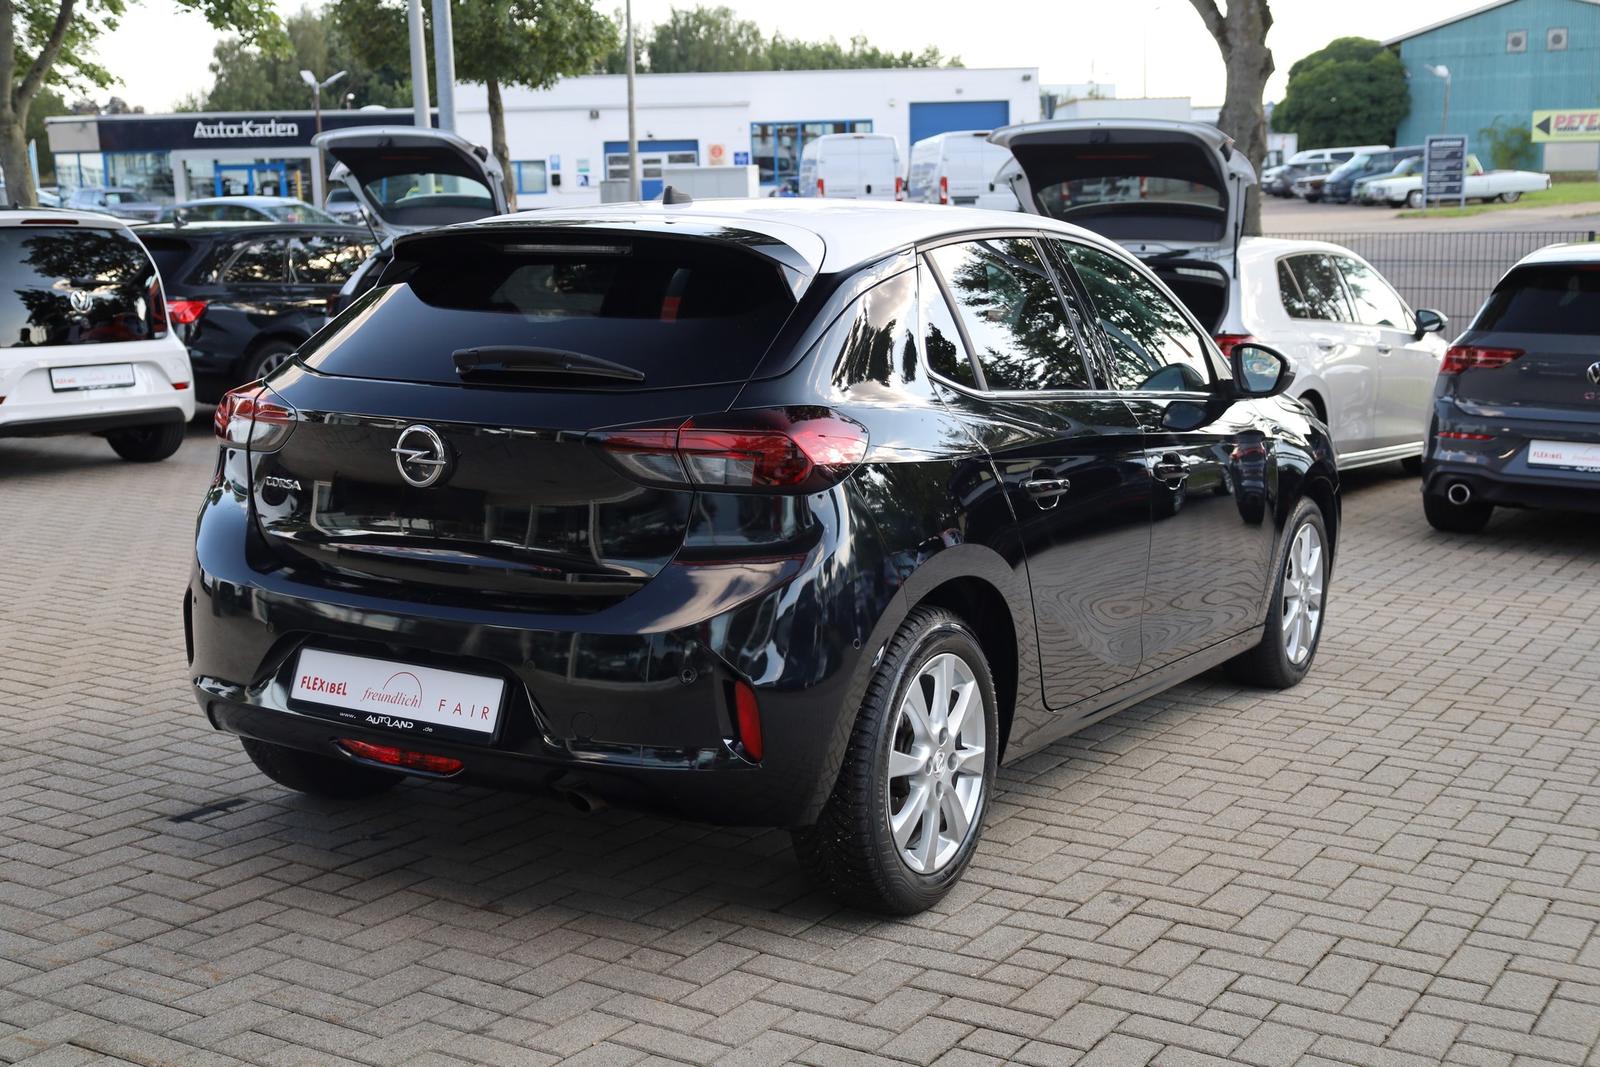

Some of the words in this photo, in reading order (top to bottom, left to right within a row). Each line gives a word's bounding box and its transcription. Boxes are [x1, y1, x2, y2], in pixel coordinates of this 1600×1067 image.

[193, 121, 239, 138] Auto
[241, 119, 298, 137] Kaden
[1552, 112, 1600, 128] PETE
[265, 476, 301, 490] CORSA
[300, 676, 347, 696] FLEXIBEL
[361, 687, 420, 709] freundlich
[338, 711, 357, 719] www.
[365, 714, 413, 729] AUTOLAND
